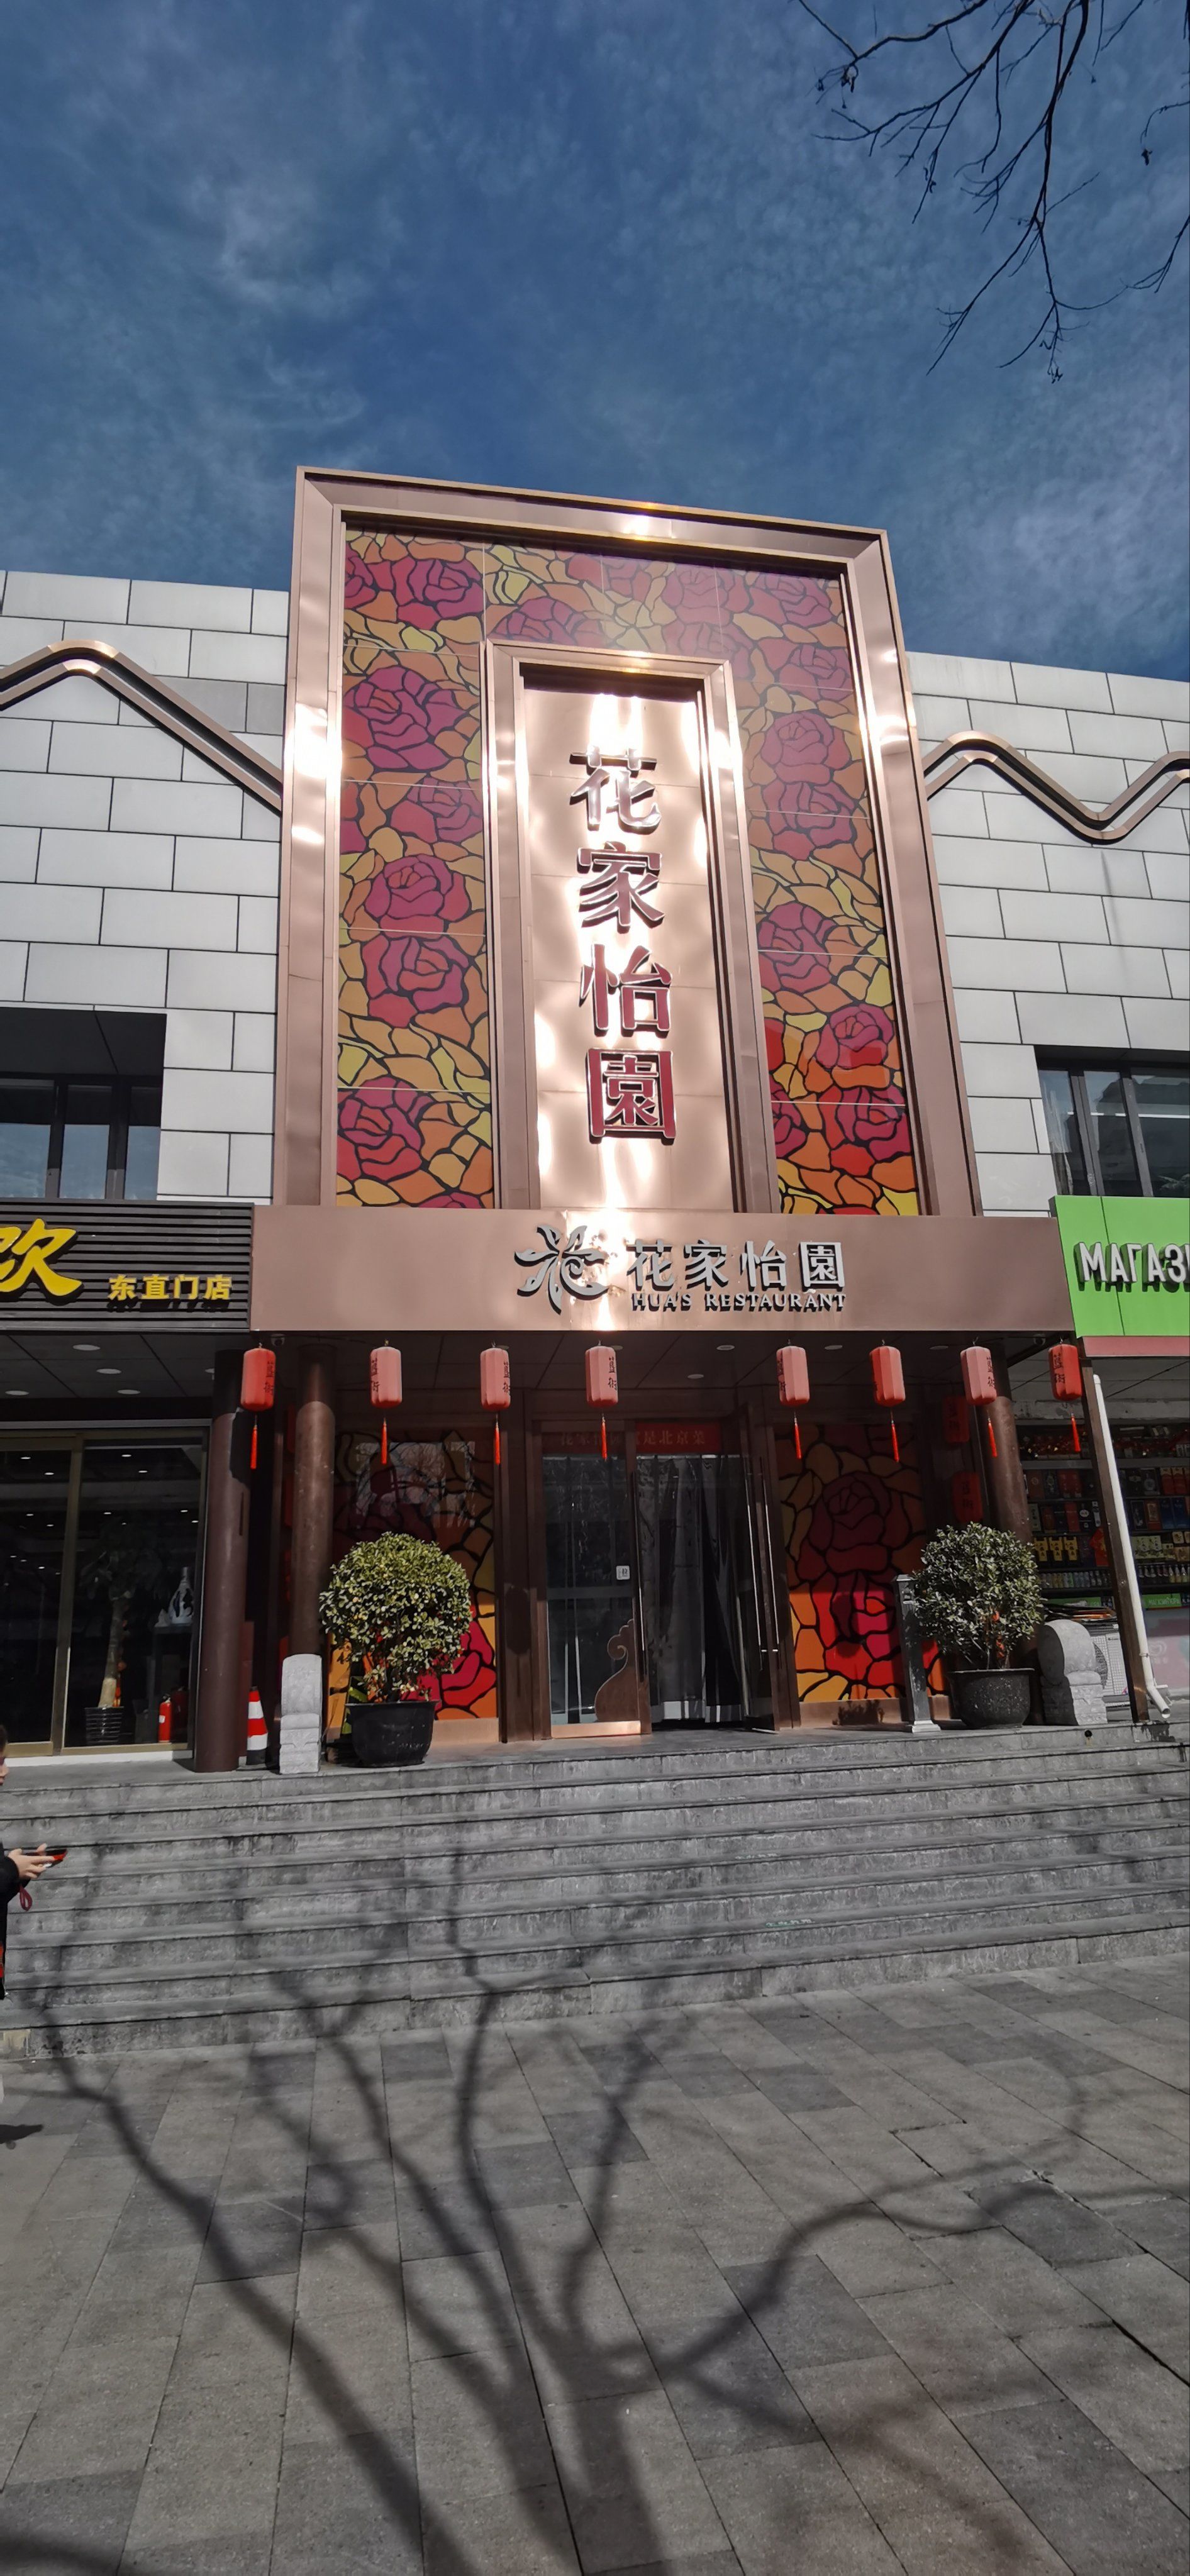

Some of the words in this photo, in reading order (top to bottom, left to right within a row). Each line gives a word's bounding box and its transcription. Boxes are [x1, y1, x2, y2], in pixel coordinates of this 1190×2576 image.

[569, 747, 677, 1144] 花家怡園
[626, 1240, 845, 1289] 花家怡園
[1074, 1241, 1189, 1284] МАГАЗ
[108, 1274, 231, 1301] 东直门店
[632, 1292, 692, 1309] HUA'S
[706, 1292, 846, 1309] RESTAURANT
